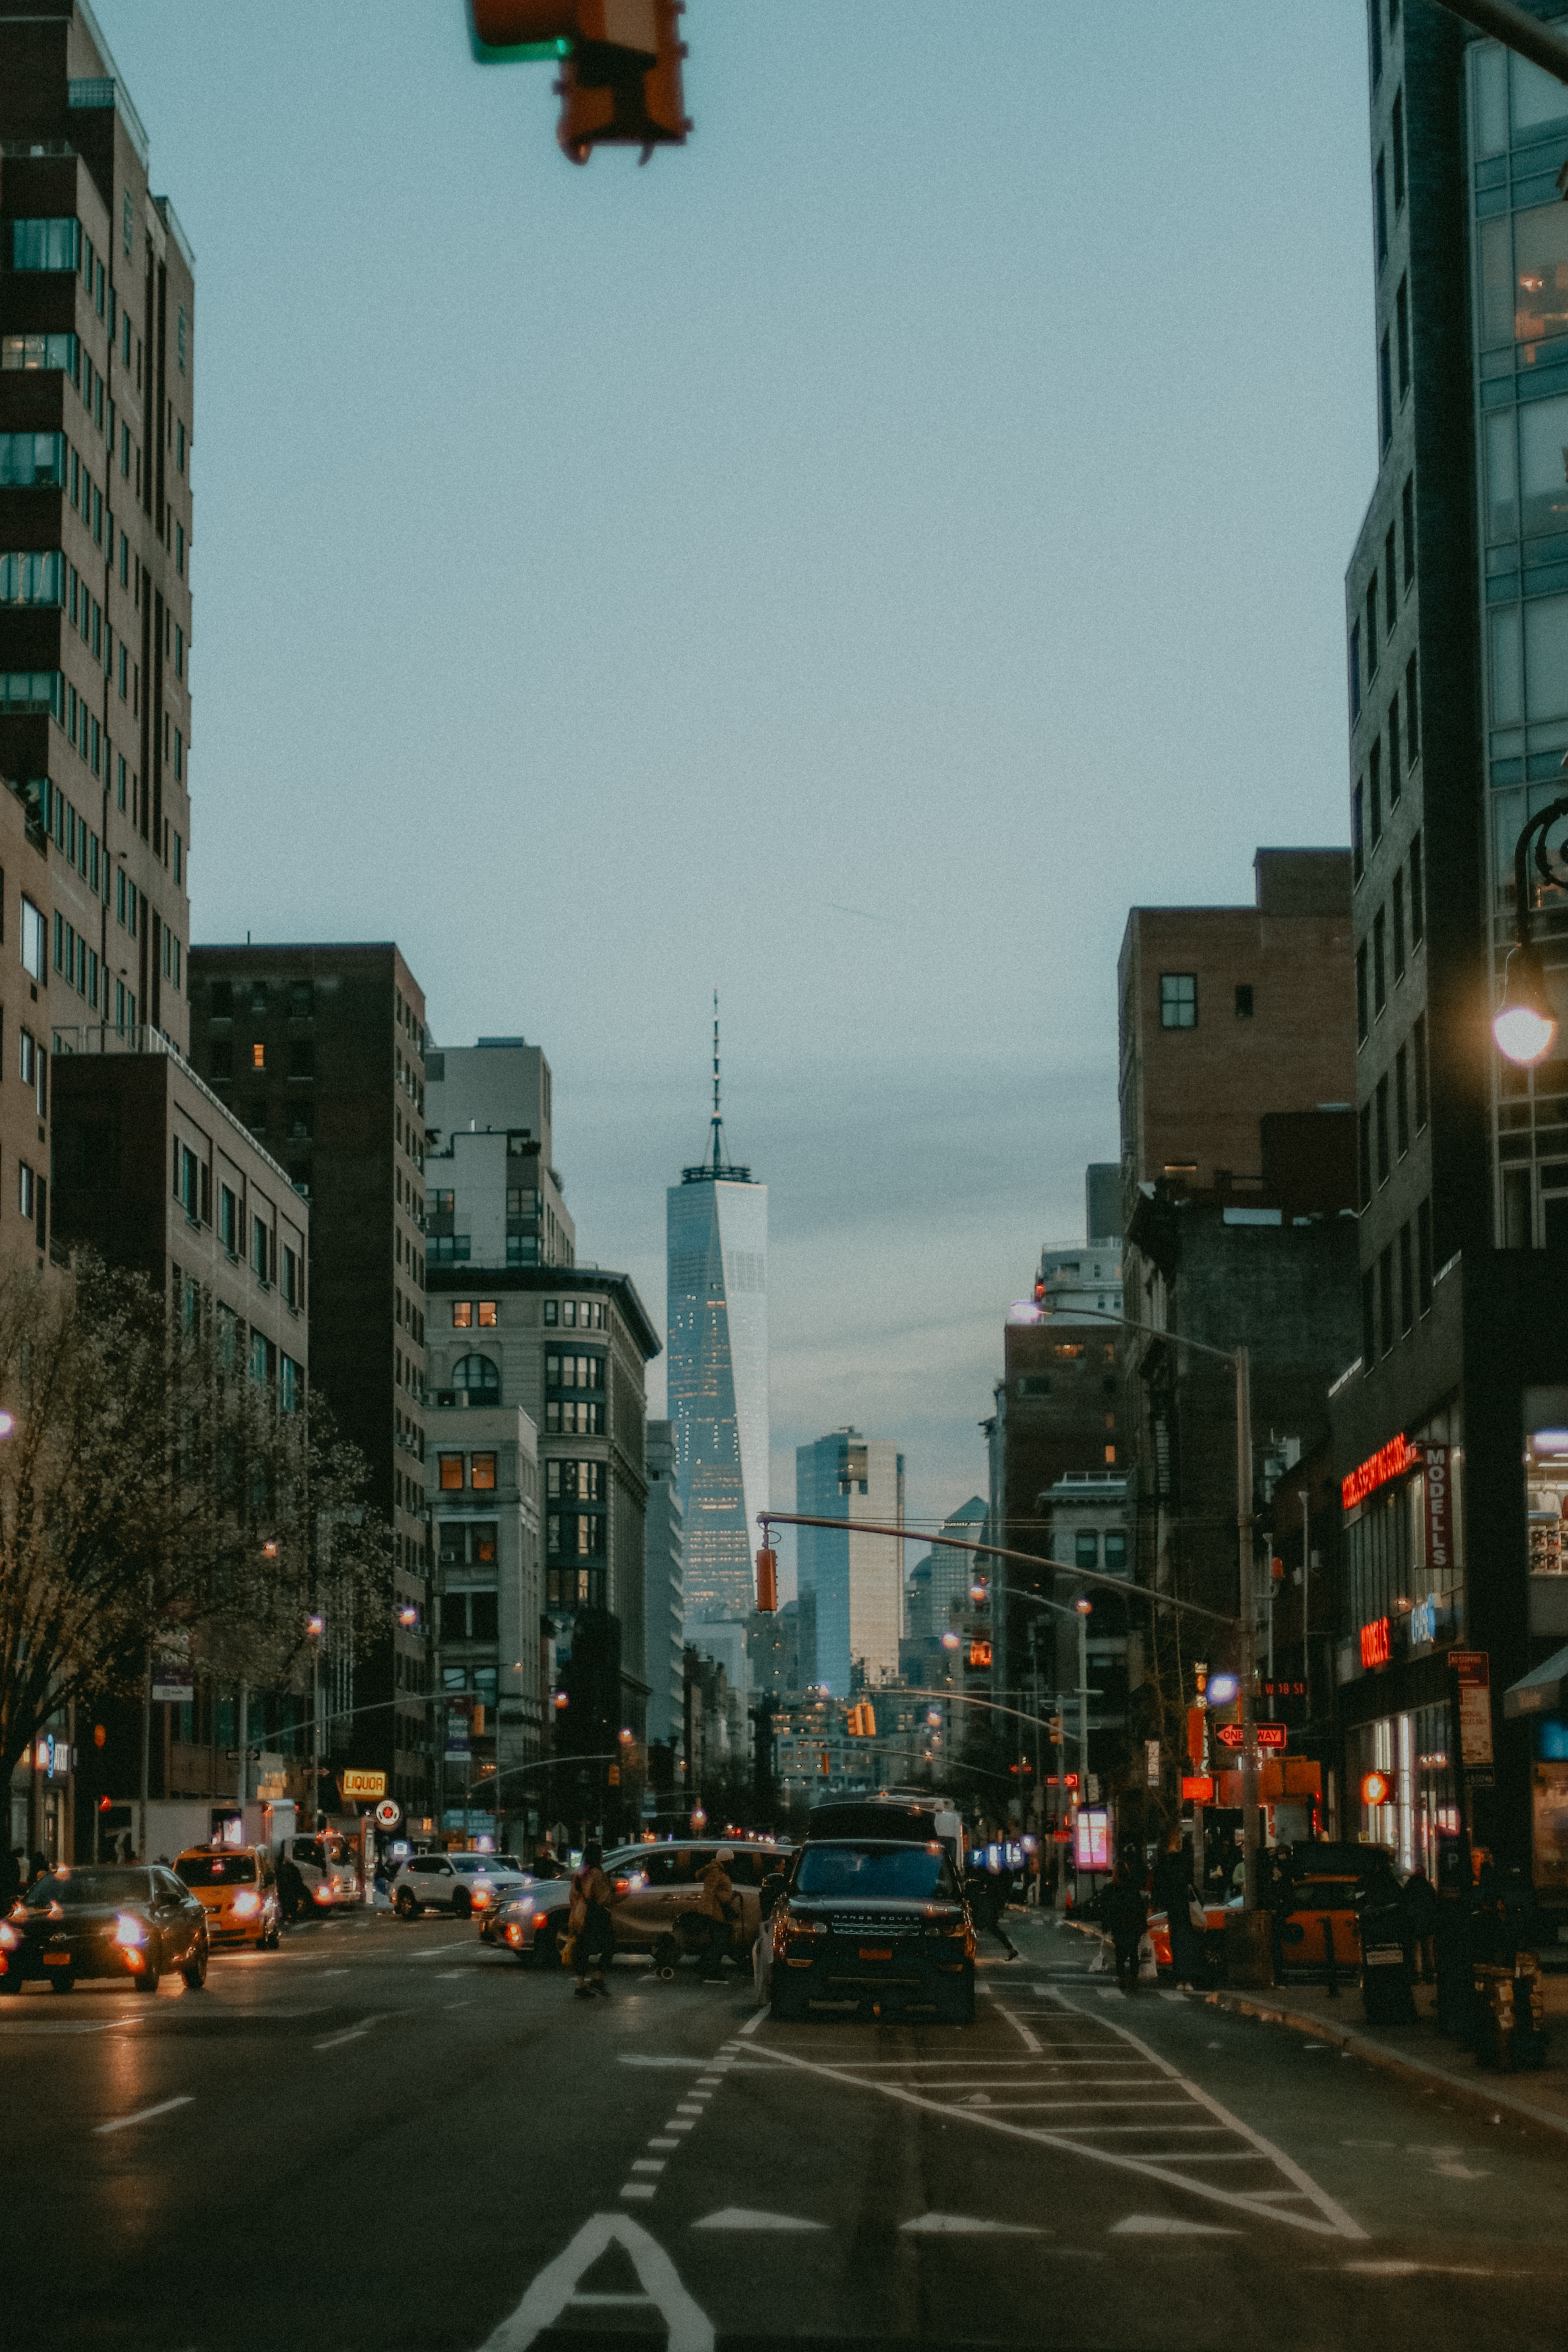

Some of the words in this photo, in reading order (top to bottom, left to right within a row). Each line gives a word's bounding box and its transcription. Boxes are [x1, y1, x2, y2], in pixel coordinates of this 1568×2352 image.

[1426, 1449, 1446, 1566] MODELLS
[1265, 1683, 1274, 1694] W
[1278, 1683, 1289, 1694] 18
[1294, 1682, 1304, 1694] St
[1224, 1731, 1243, 1740] ONE
[1258, 1731, 1278, 1740] WAY
[345, 1775, 383, 1791] LIQUOR
[475, 2213, 716, 2352] A
